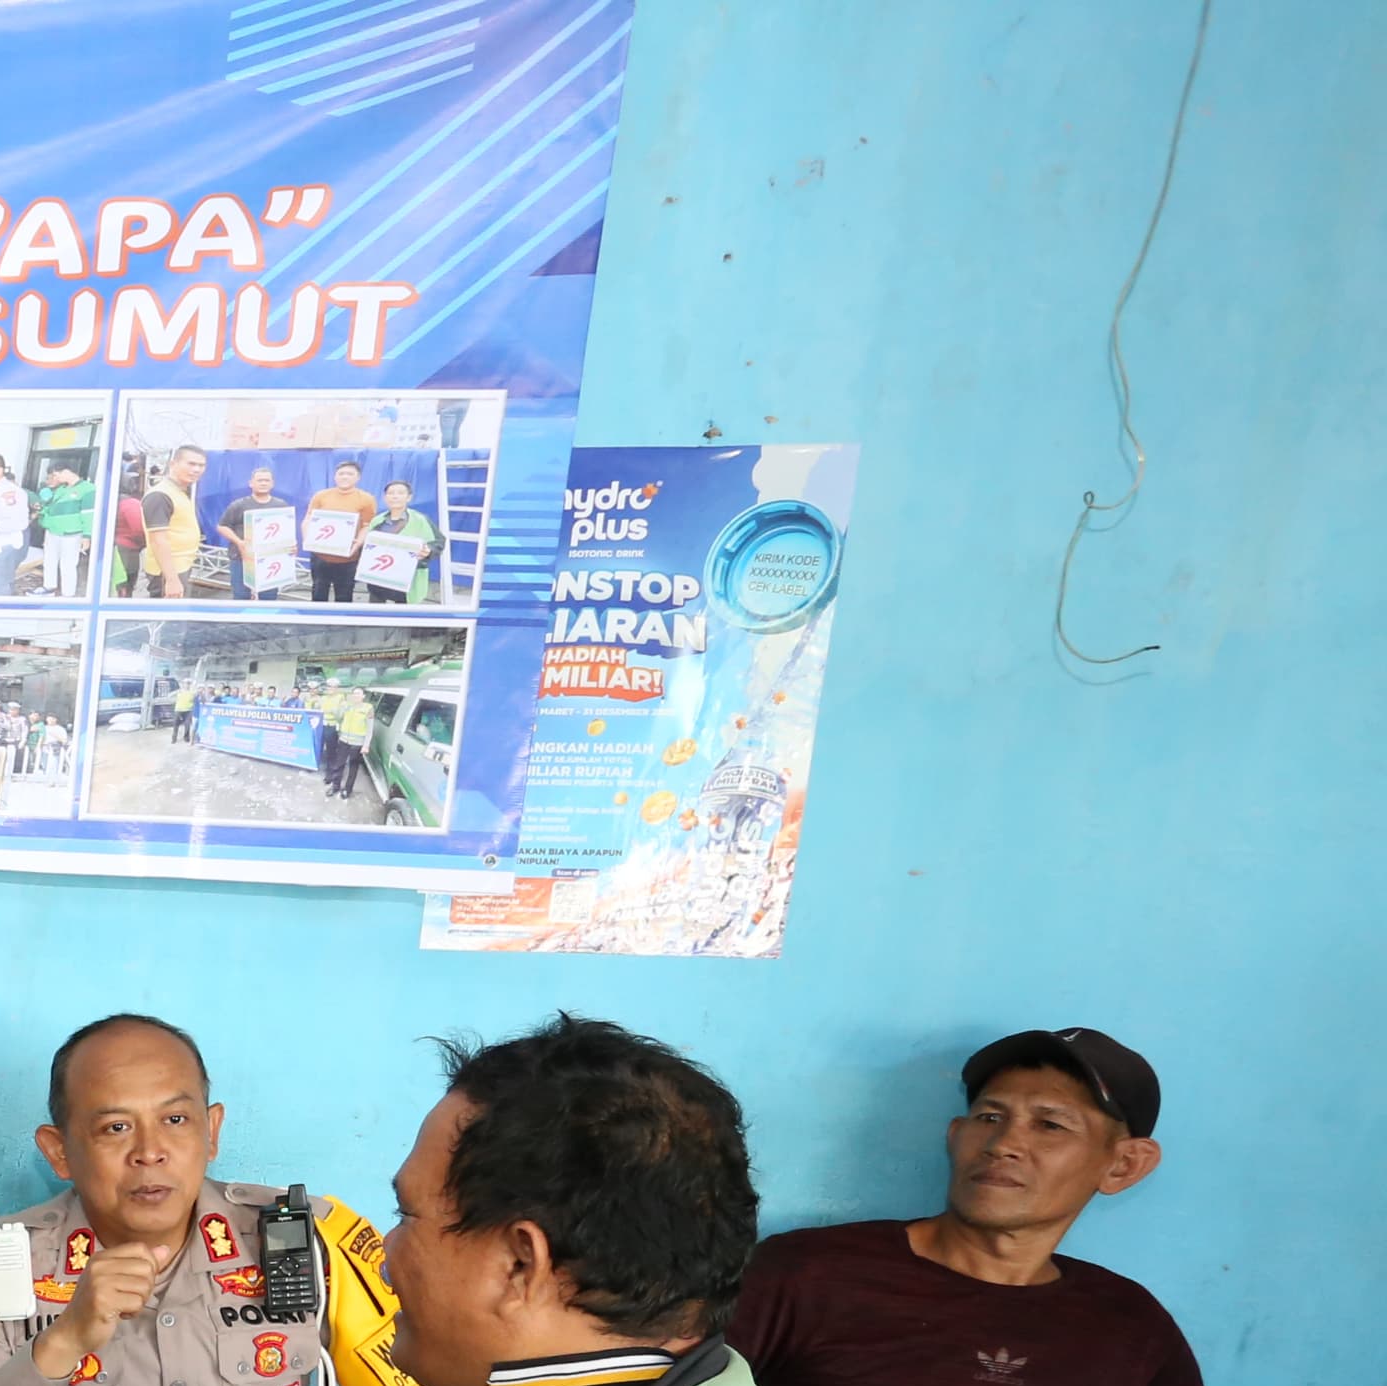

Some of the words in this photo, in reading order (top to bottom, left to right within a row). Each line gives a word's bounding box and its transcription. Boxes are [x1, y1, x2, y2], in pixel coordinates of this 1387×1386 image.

[570, 512, 648, 546] plus
[786, 554, 821, 567] KODE
[552, 571, 700, 606] NSTOP
[748, 580, 772, 593] CEK
[772, 582, 809, 597] LABEL
[546, 607, 707, 651] IARAN
[546, 648, 626, 664] HADIAH
[543, 666, 663, 693] MILIAR!
[531, 743, 590, 754] NGKAN
[593, 744, 654, 754] HADIAH
[575, 766, 633, 777] RUPIAH
[548, 848, 578, 857] BIAYA
[581, 849, 623, 857] APAPUN
